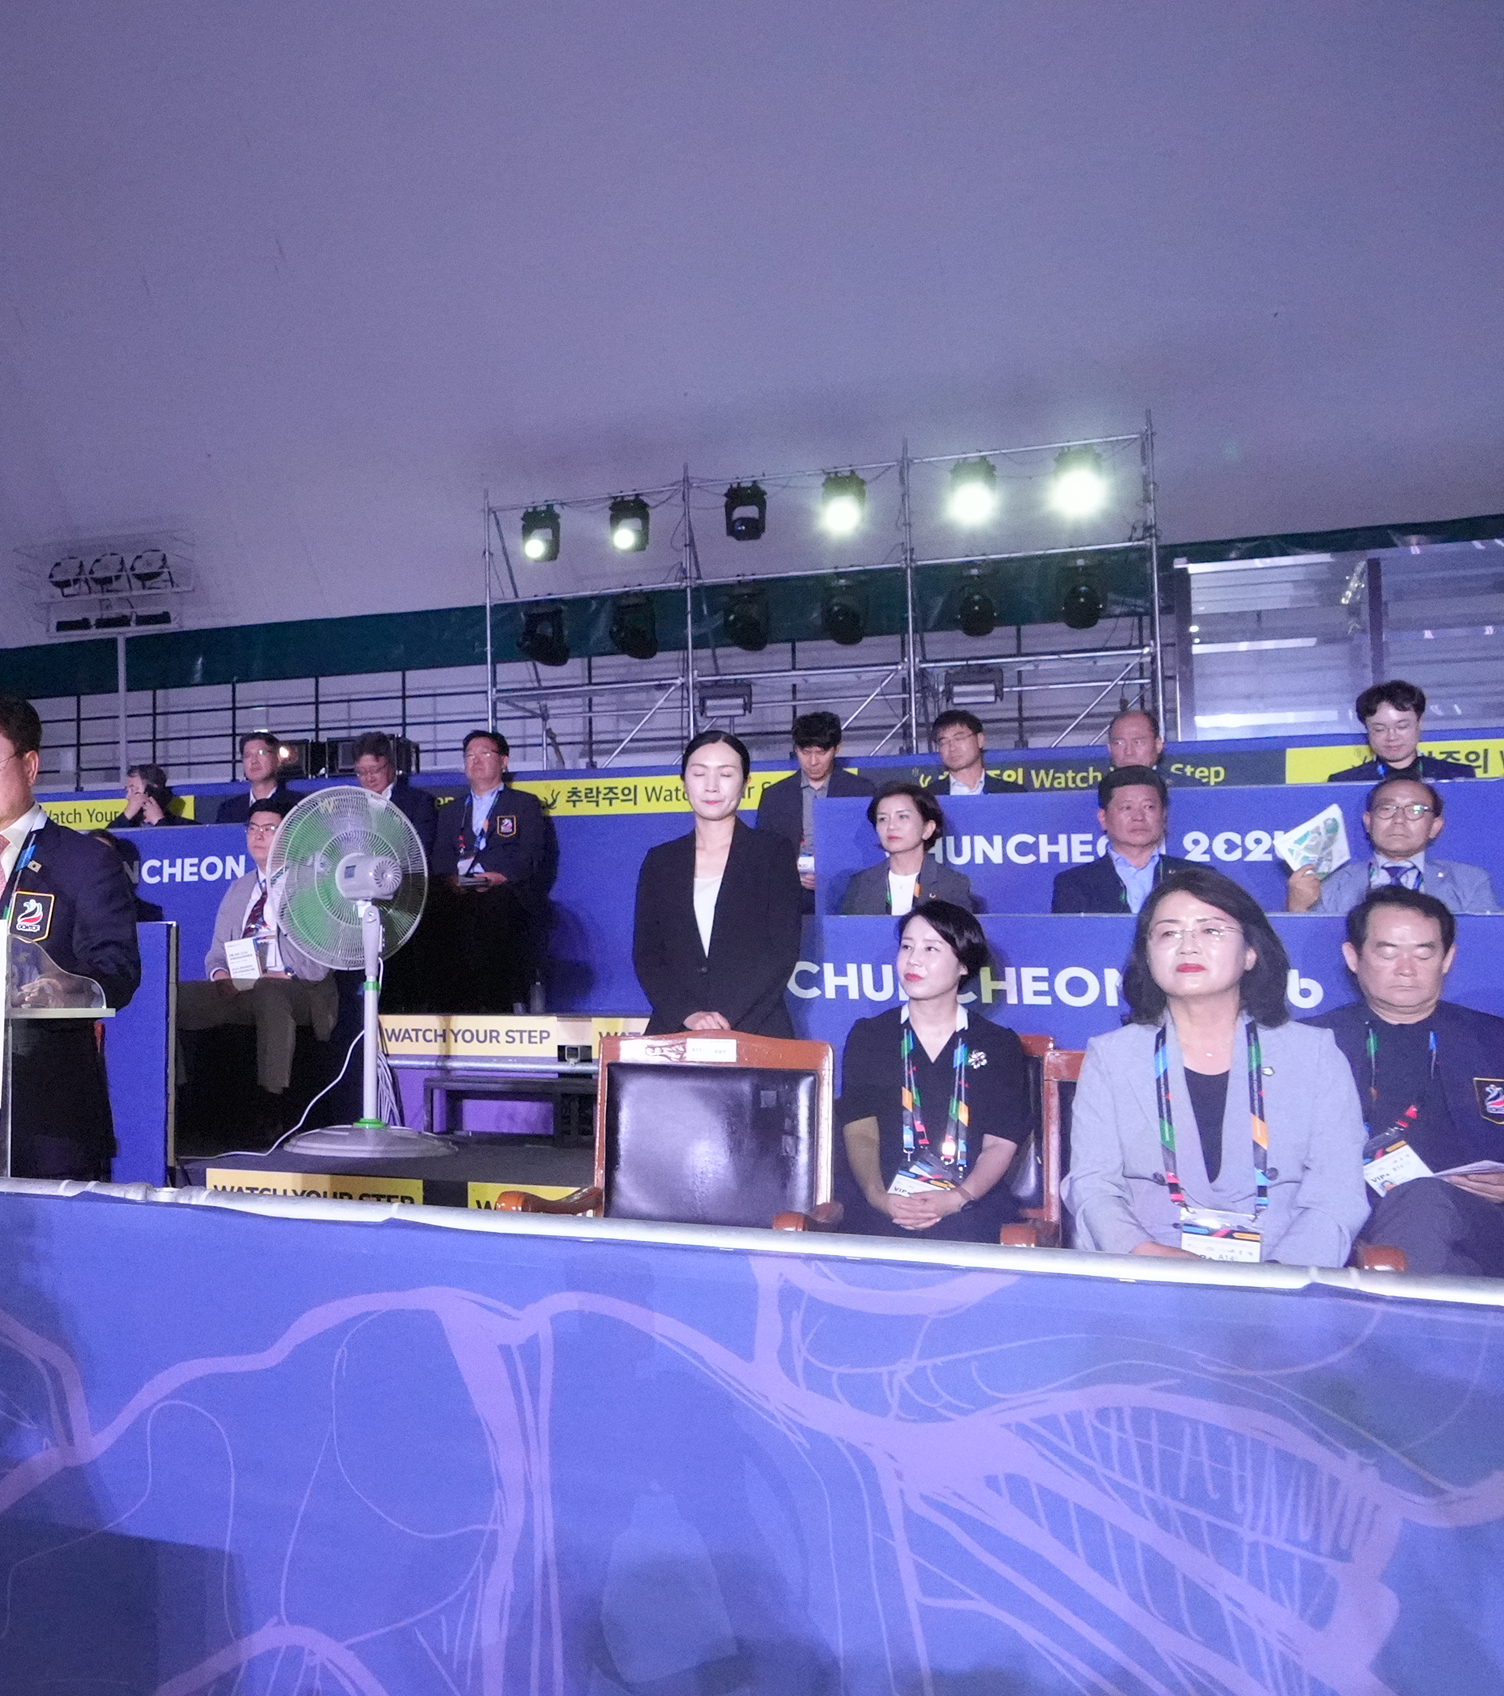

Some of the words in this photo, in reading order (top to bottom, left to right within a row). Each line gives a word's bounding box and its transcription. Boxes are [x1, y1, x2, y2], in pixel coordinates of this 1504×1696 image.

[1030, 766, 1103, 789] Watch
[566, 784, 638, 808] 추락주의
[645, 784, 692, 803] Watc
[87, 808, 120, 823] Your
[928, 833, 1107, 866] UNCHE
[124, 854, 246, 885] NCHEON
[385, 1027, 447, 1045] WATCH
[450, 1028, 500, 1046] YOUR
[505, 1029, 551, 1046] STEP
